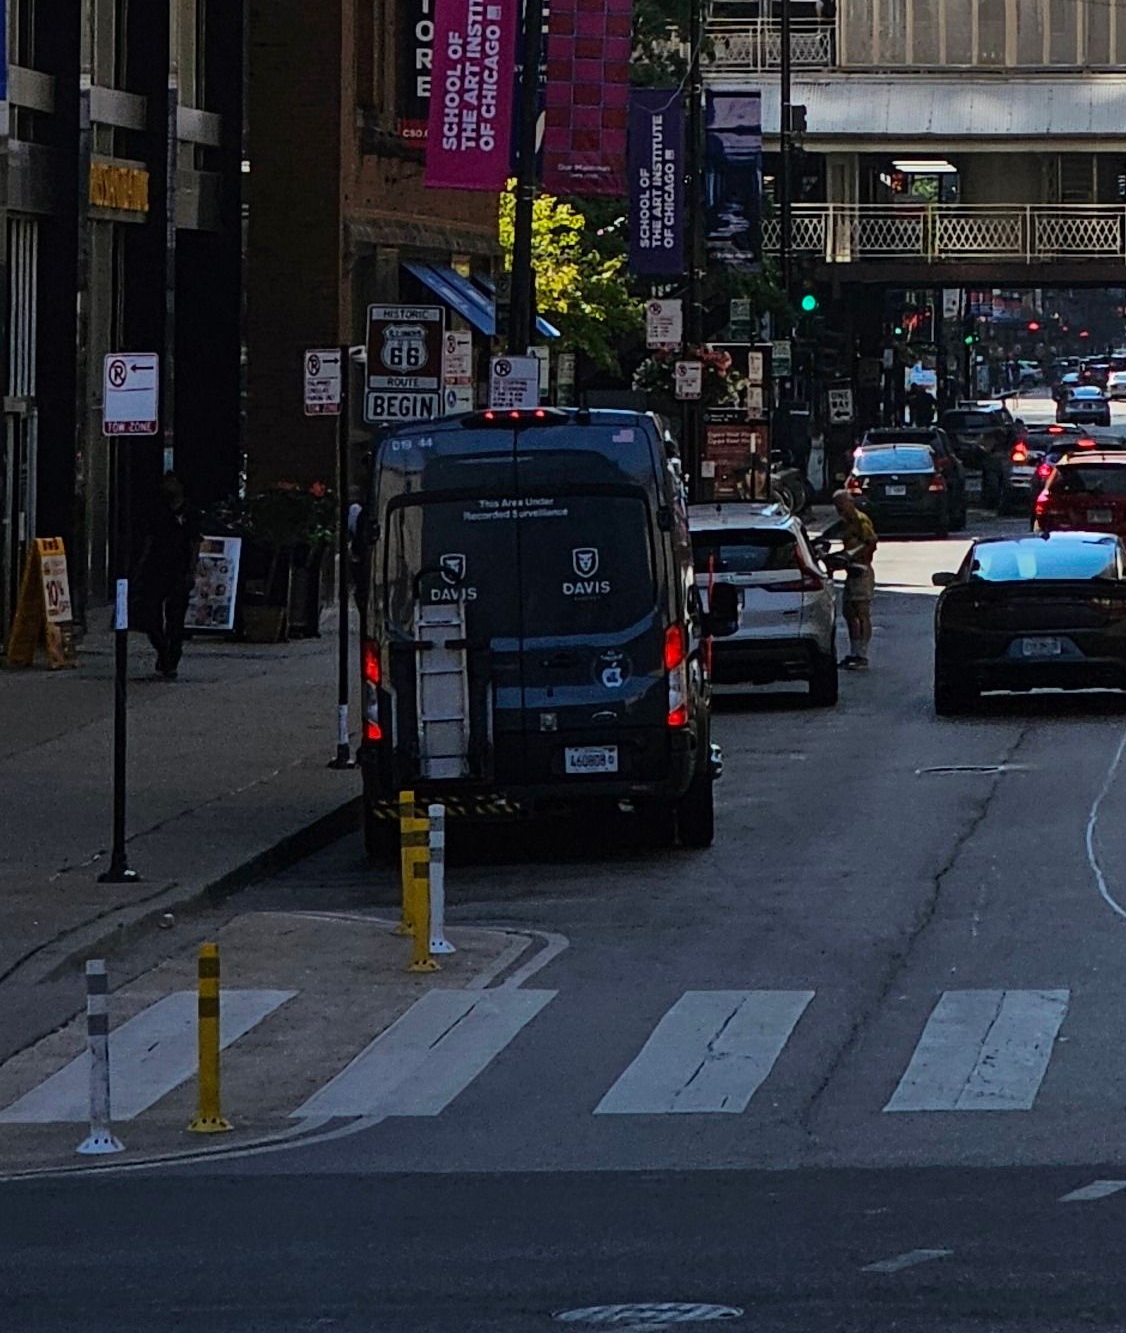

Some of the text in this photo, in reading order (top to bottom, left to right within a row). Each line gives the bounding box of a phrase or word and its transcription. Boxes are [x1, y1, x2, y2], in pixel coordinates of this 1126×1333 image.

[442, 32, 463, 150] SCHOOL OF
[462, 62, 480, 104] ART
[479, 25, 501, 151] OF CHICAGO
[461, 109, 477, 151] THE
[652, 114, 663, 248] THE ART INSTITUTE
[640, 168, 650, 248] SCHOOL OF
[664, 162, 675, 249] OF CHICAGO
[383, 309, 429, 319] HISTORIC
[390, 347, 420, 366] 66
[387, 377, 419, 387] ROUTE
[373, 395, 433, 418] BEGIN
[107, 423, 153, 433] TOW ZONE
[525, 497, 554, 507] Under
[431, 587, 477, 601] DAVIS
[562, 581, 611, 595] DAVIS
